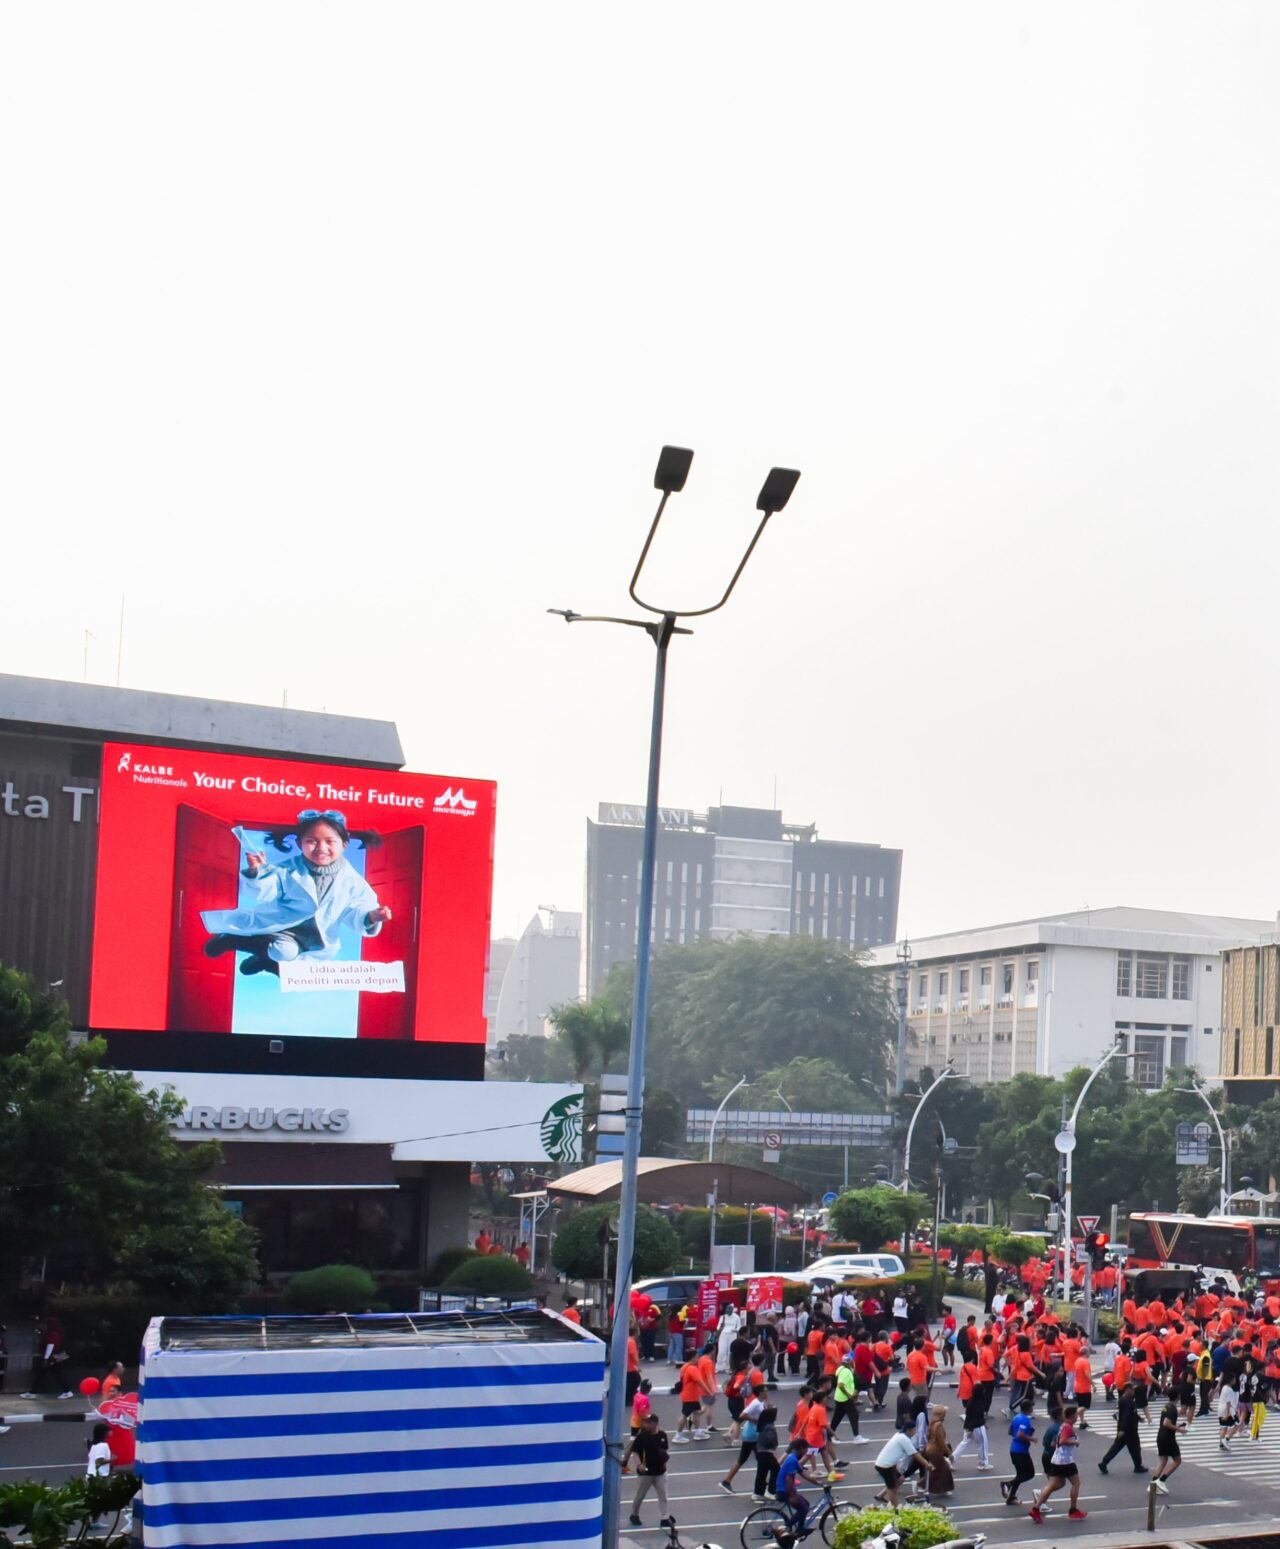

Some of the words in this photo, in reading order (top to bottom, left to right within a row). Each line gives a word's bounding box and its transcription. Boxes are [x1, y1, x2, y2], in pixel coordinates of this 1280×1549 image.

[133, 764, 174, 776] KALBE
[133, 773, 187, 788] Nutritionals
[192, 771, 236, 790] Your
[241, 777, 312, 800] Choice,
[316, 783, 361, 802] Their
[367, 789, 425, 808] Future
[62, 786, 101, 824] T
[309, 965, 336, 974] Lidia
[364, 976, 399, 987] depan
